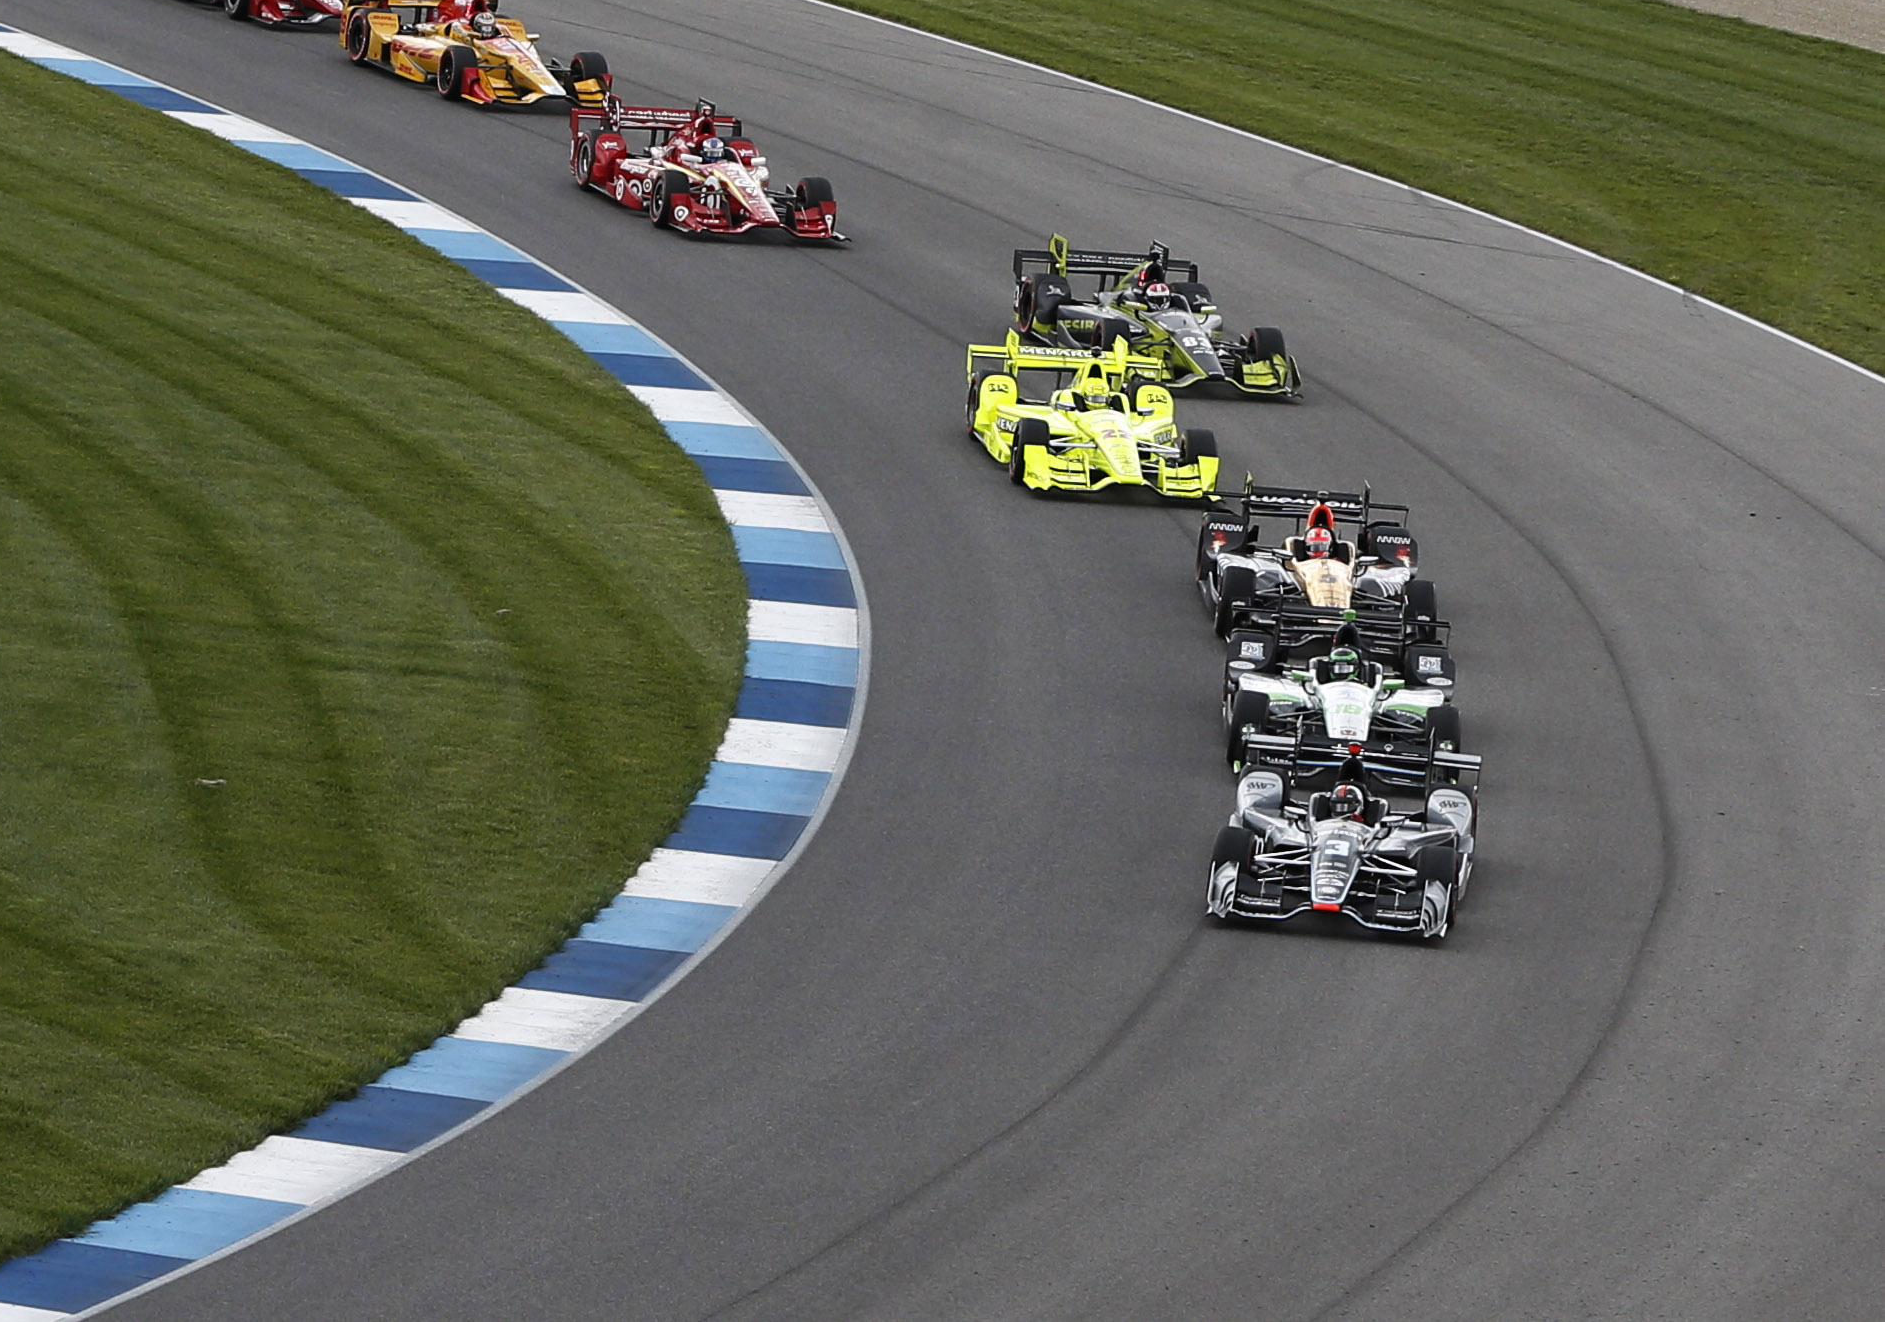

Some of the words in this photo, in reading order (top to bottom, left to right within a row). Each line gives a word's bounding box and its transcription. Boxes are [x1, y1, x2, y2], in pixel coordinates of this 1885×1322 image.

[1020, 346, 1106, 360] MENARS
[1326, 501, 1363, 509] OIL
[1325, 839, 1350, 856] 3
